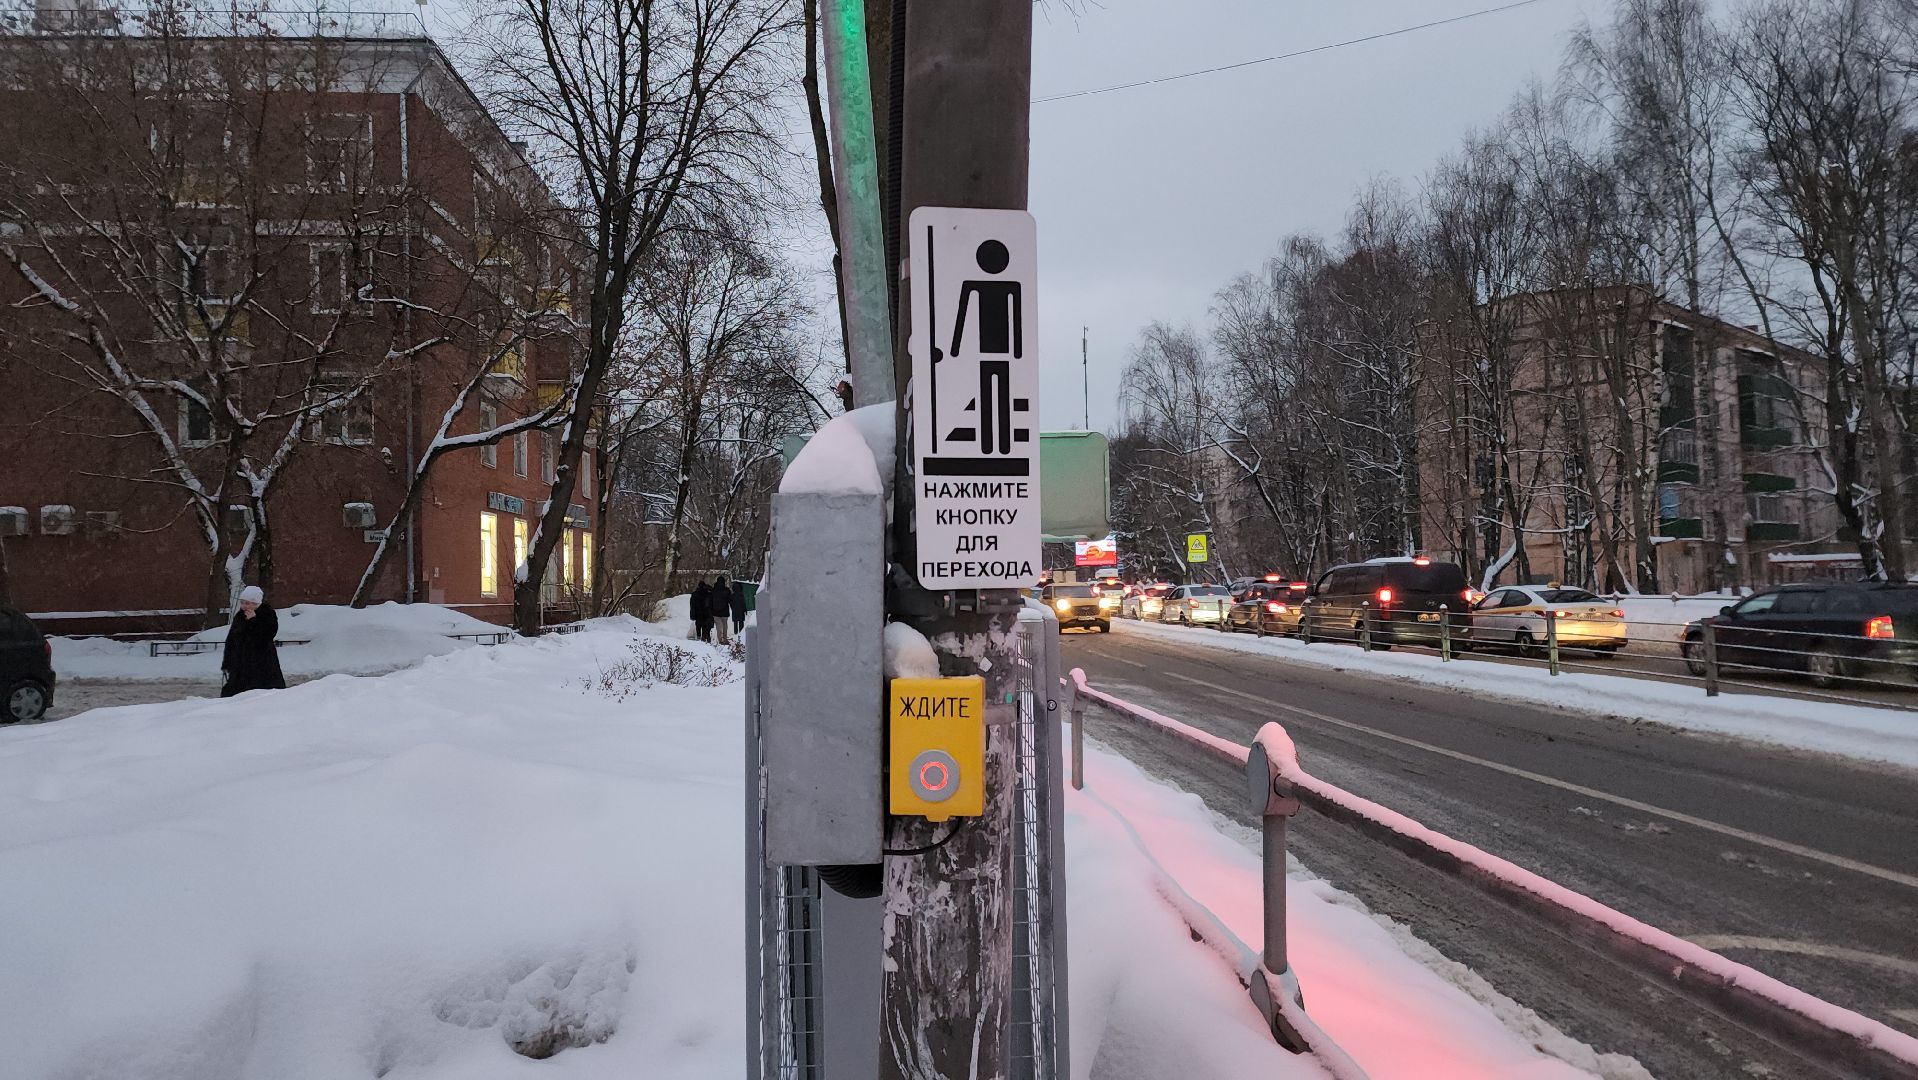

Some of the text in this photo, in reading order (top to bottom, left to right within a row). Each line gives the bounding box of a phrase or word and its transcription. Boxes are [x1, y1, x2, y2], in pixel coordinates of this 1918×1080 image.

[924, 482, 1029, 499] НАЖМИТЕ
[936, 508, 1018, 525] КНОПКУ
[955, 535, 998, 555] ДЛЯ
[922, 560, 1034, 580] ПЕРЕХОДА
[899, 696, 970, 721] ЖДИТЕ
